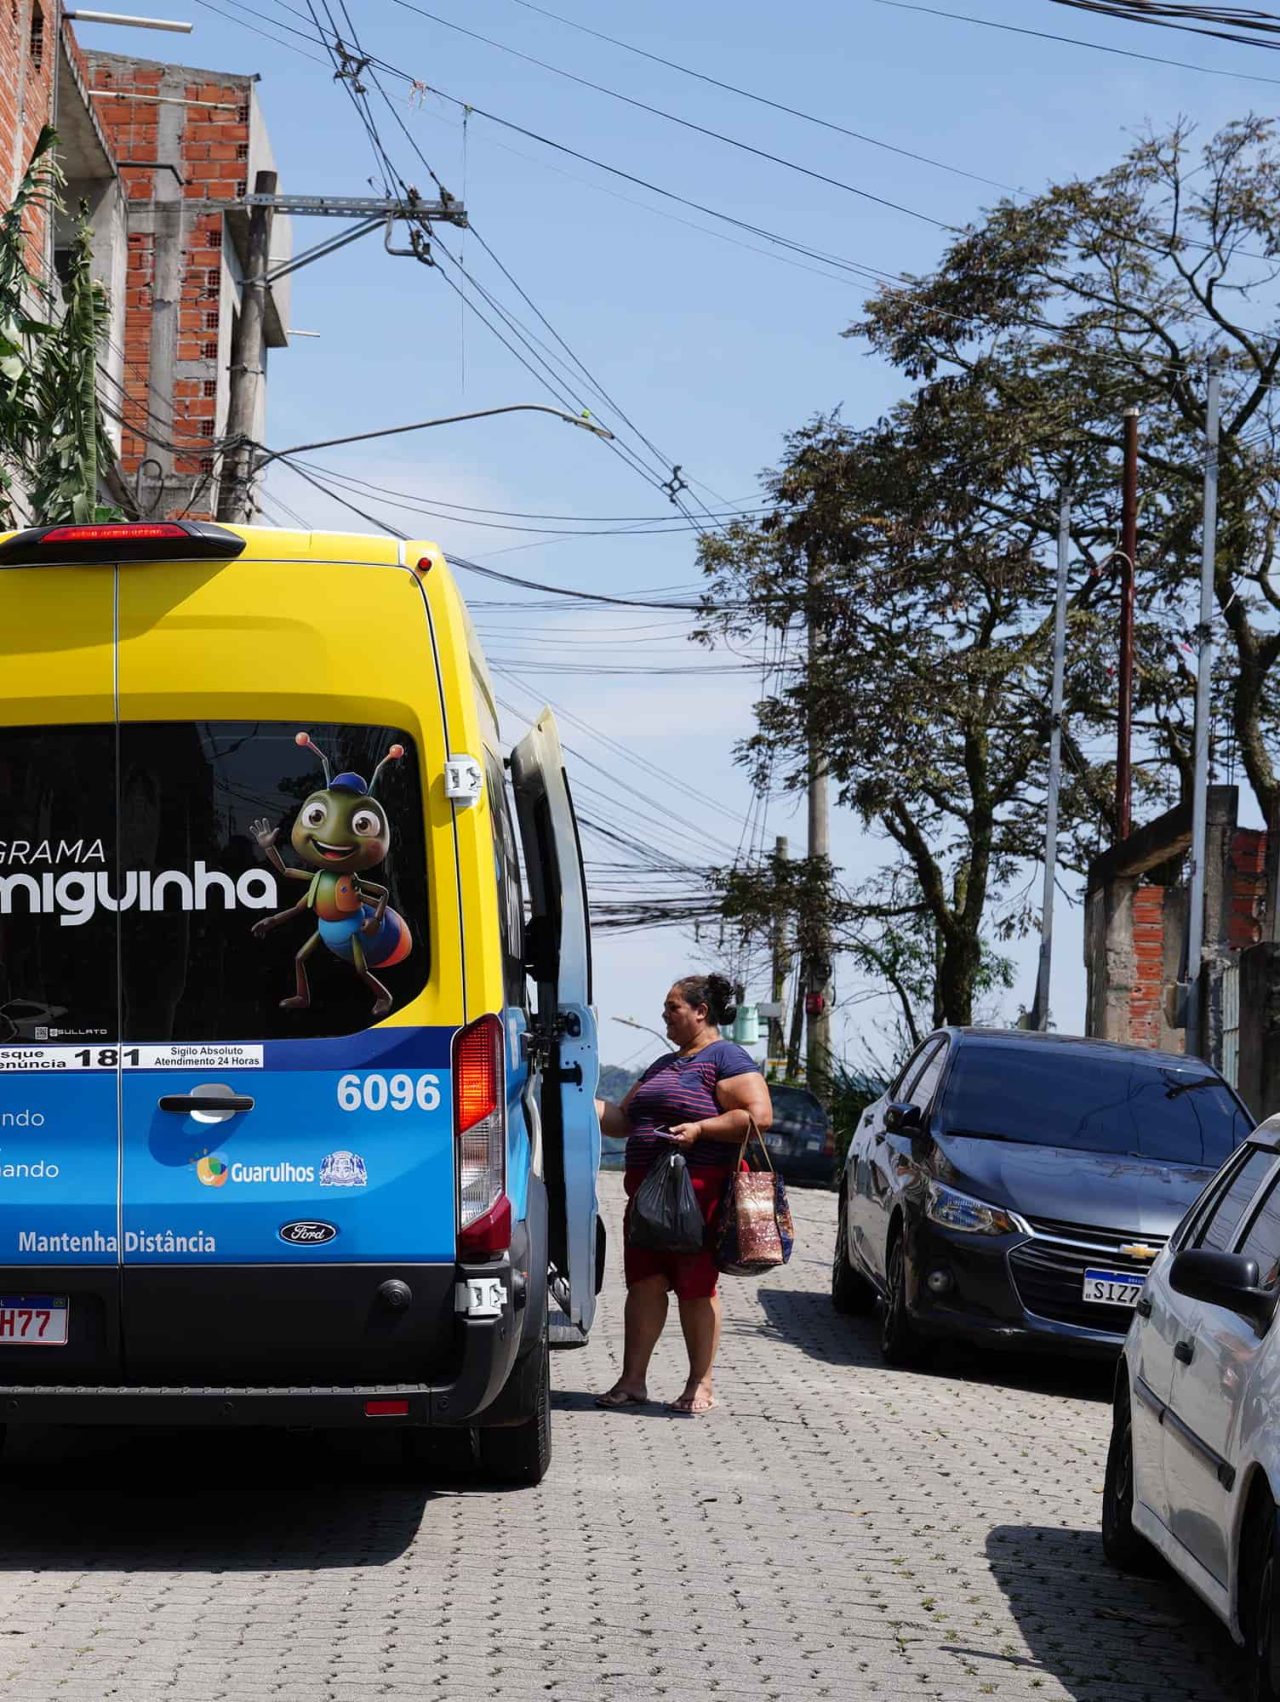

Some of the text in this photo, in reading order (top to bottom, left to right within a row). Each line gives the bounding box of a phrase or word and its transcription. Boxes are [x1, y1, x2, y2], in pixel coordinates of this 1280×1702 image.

[74, 1048, 140, 1067] 181
[155, 1056, 260, 1067] Atendimento 24 Horas
[171, 1046, 243, 1057] Sigilo Absoluto
[336, 1073, 441, 1111] 6096
[231, 1162, 315, 1183] Guarulhos
[19, 1229, 216, 1252] Mantenha Distância
[291, 1225, 325, 1240] Ford
[1093, 1281, 1140, 1303] SIZ7
